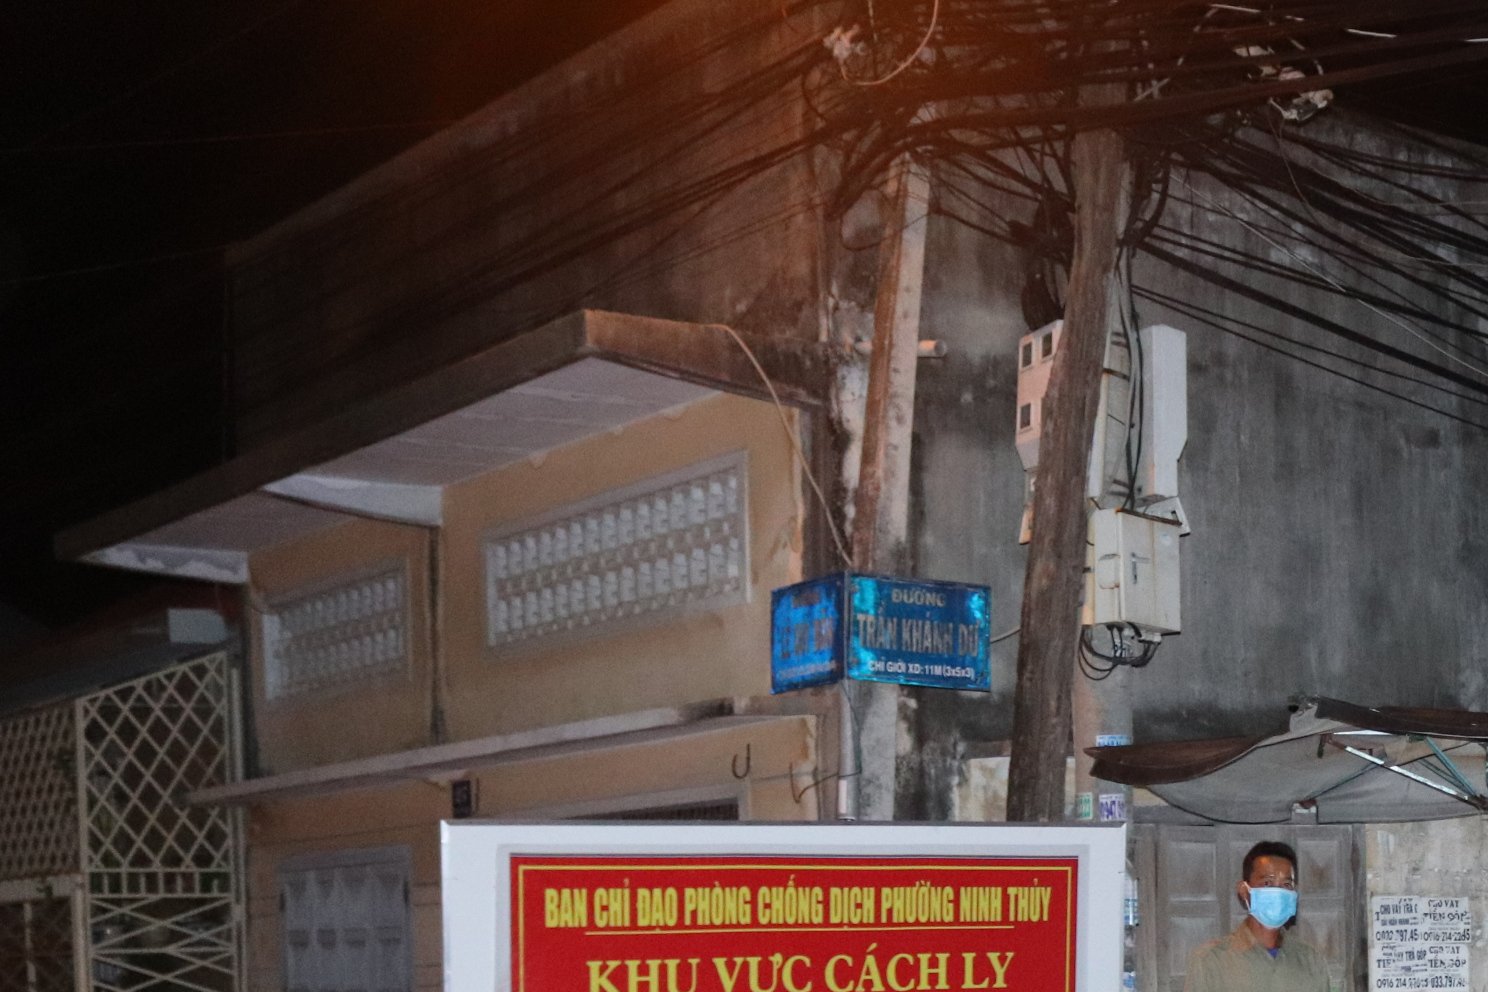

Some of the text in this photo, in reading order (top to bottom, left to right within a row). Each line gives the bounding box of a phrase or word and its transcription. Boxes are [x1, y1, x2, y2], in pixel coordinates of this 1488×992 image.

[901, 611, 954, 656] KHÁNH
[544, 874, 1052, 931] BAN CHỈ ĐẠO PHÒNG CHỐNG DỊCH PHƯỜNG NINH THỦY
[961, 951, 1015, 989] LY
